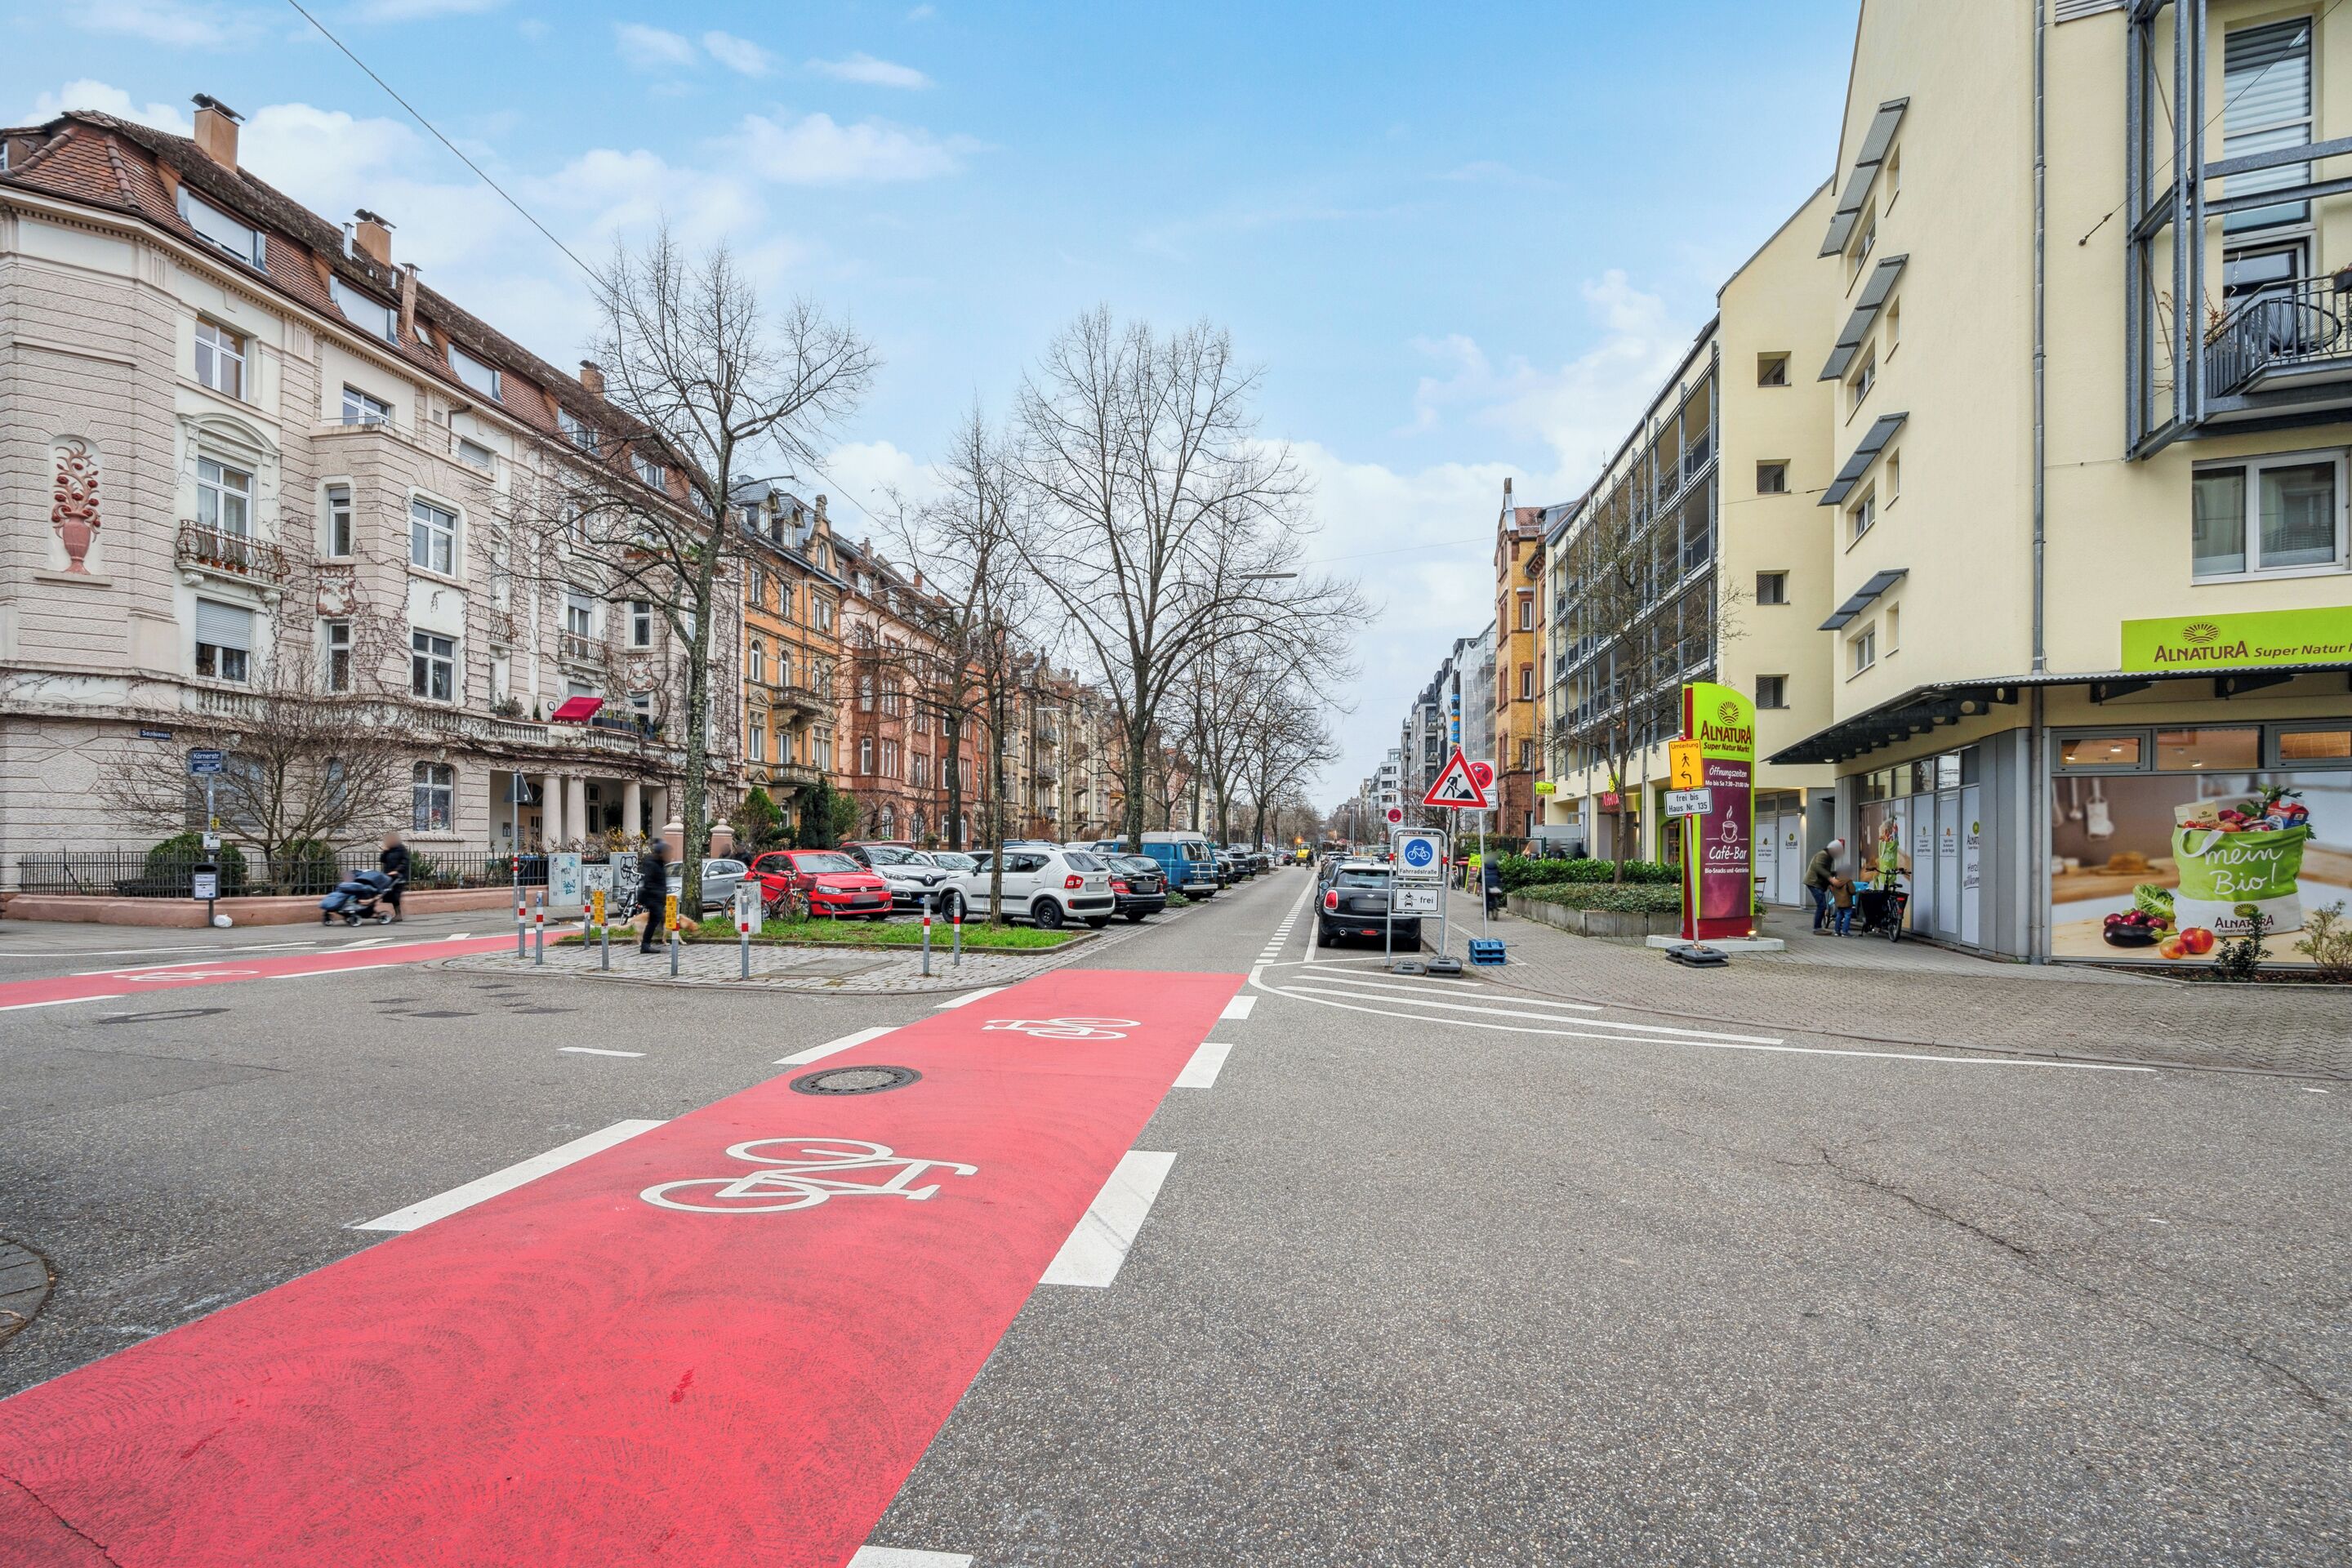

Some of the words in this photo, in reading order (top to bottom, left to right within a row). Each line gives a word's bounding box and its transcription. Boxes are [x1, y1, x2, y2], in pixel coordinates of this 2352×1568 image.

[2154, 640, 2248, 662] ALNATURA
[2254, 647, 2297, 657] Super
[2301, 644, 2345, 655] Natur
[1700, 720, 1752, 745] ALNATURA
[1709, 764, 1747, 779] Öffnungszeiten
[1709, 845, 1747, 860] Café-Bar
[2205, 839, 2283, 865] mein
[2209, 862, 2277, 894] Bio!
[2215, 915, 2274, 928] ALNATRA
